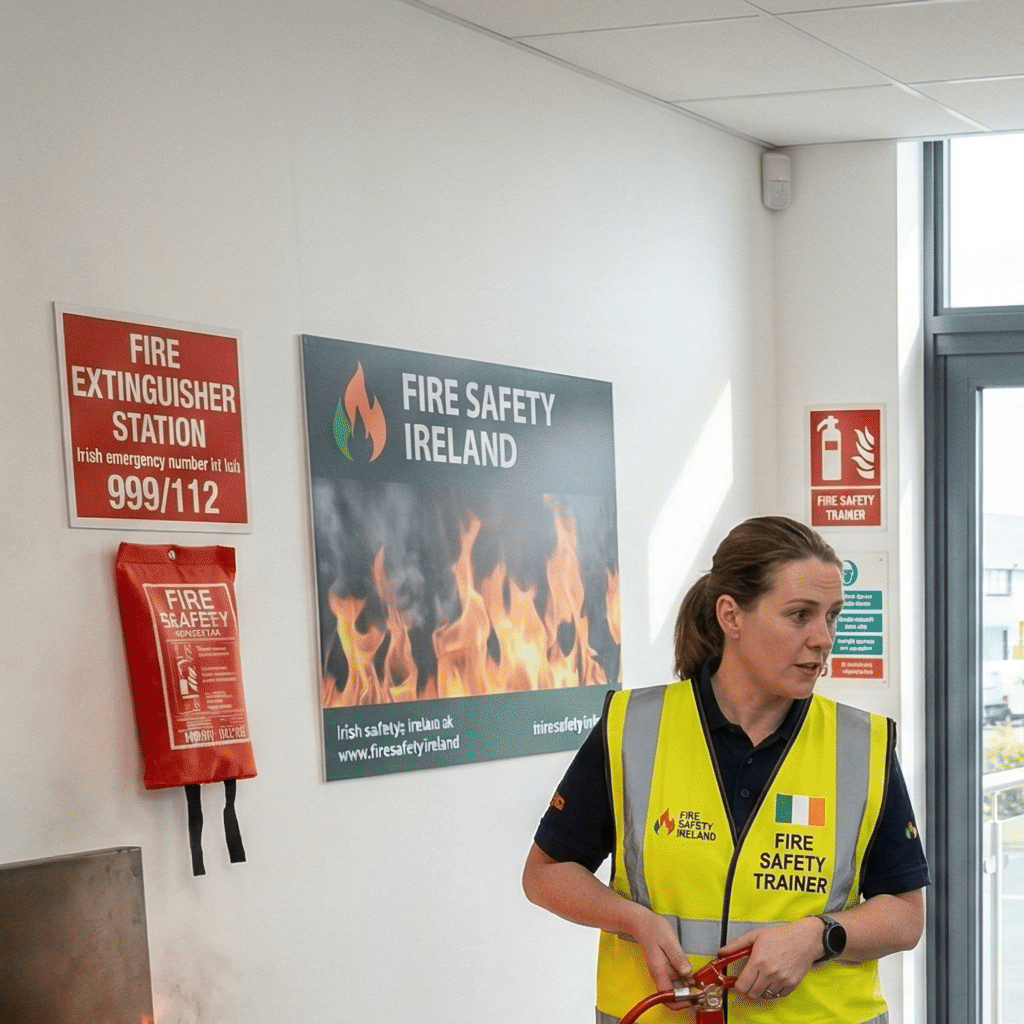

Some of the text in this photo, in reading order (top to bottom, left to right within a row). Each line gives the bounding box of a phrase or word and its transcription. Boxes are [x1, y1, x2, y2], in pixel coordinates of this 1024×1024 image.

[129, 333, 181, 369] FIRE
[71, 365, 237, 413] EXTINGUISHER
[402, 372, 555, 426] FIRE SAFETY
[112, 410, 207, 448] STATION
[404, 422, 518, 469] IRELAND
[76, 447, 103, 464] Irish
[106, 452, 165, 471] emergency
[168, 456, 208, 471] number
[107, 473, 220, 514] 999/112
[817, 494, 875, 507] FIRE SAFETY
[825, 509, 866, 521] TRAINER
[164, 588, 215, 610] FIRE
[337, 723, 363, 741] Irish
[679, 810, 701, 821] FIRE
[774, 832, 814, 851] FIRE
[759, 852, 827, 873] SAFETY
[753, 872, 828, 894] TRAINER
